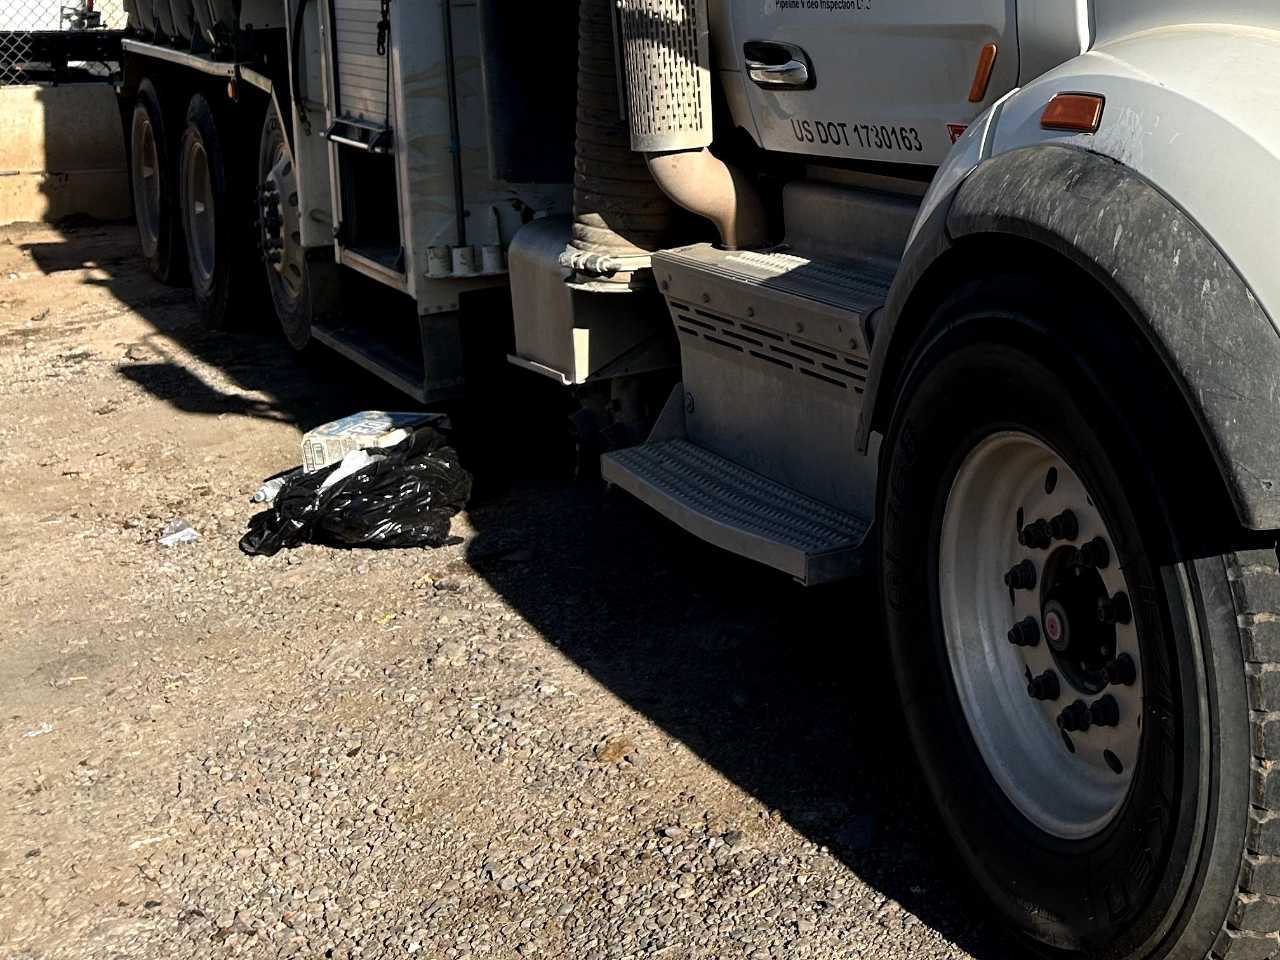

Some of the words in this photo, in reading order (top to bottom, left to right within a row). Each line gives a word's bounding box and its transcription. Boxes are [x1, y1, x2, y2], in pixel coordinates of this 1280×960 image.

[791, 119, 814, 142] US
[815, 121, 849, 146] DOT
[854, 124, 923, 151] 1730163
